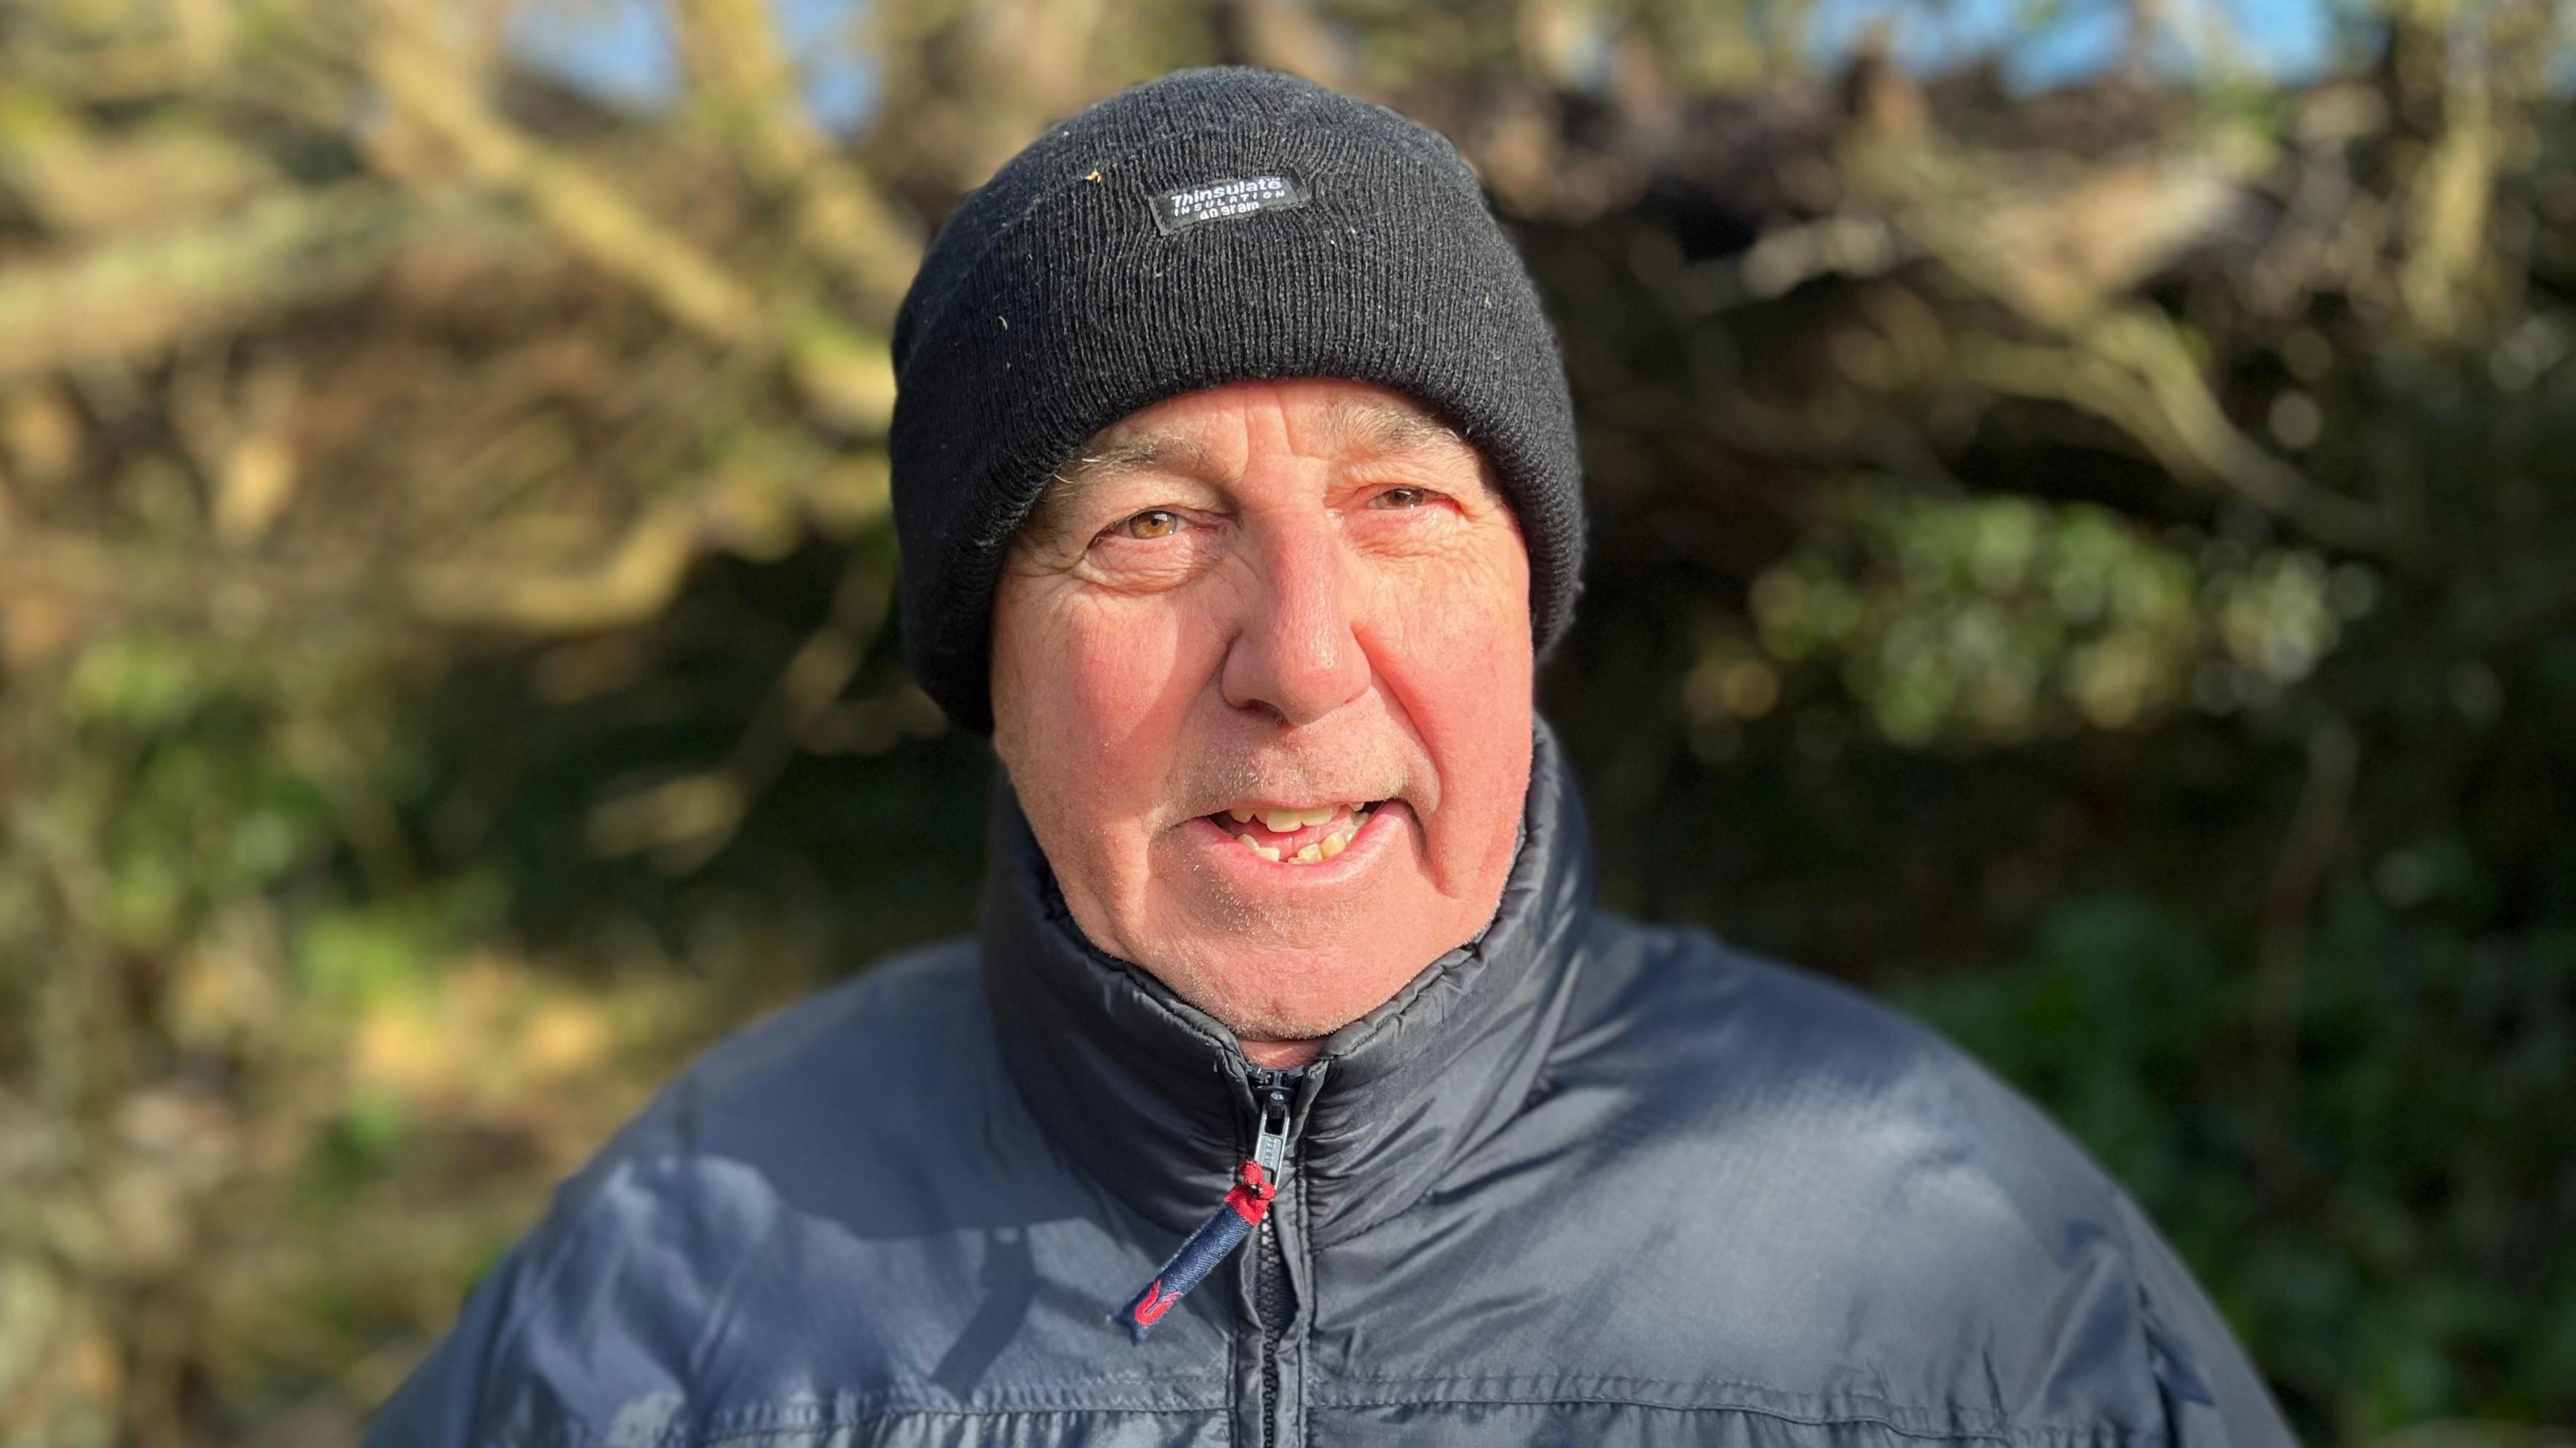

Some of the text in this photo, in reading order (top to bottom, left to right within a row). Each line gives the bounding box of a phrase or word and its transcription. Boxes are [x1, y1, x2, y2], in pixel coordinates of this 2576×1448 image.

[1171, 178, 1282, 208] Thinsulate
[1174, 190, 1285, 217] INSULATION
[1199, 201, 1260, 220] 40 gram
